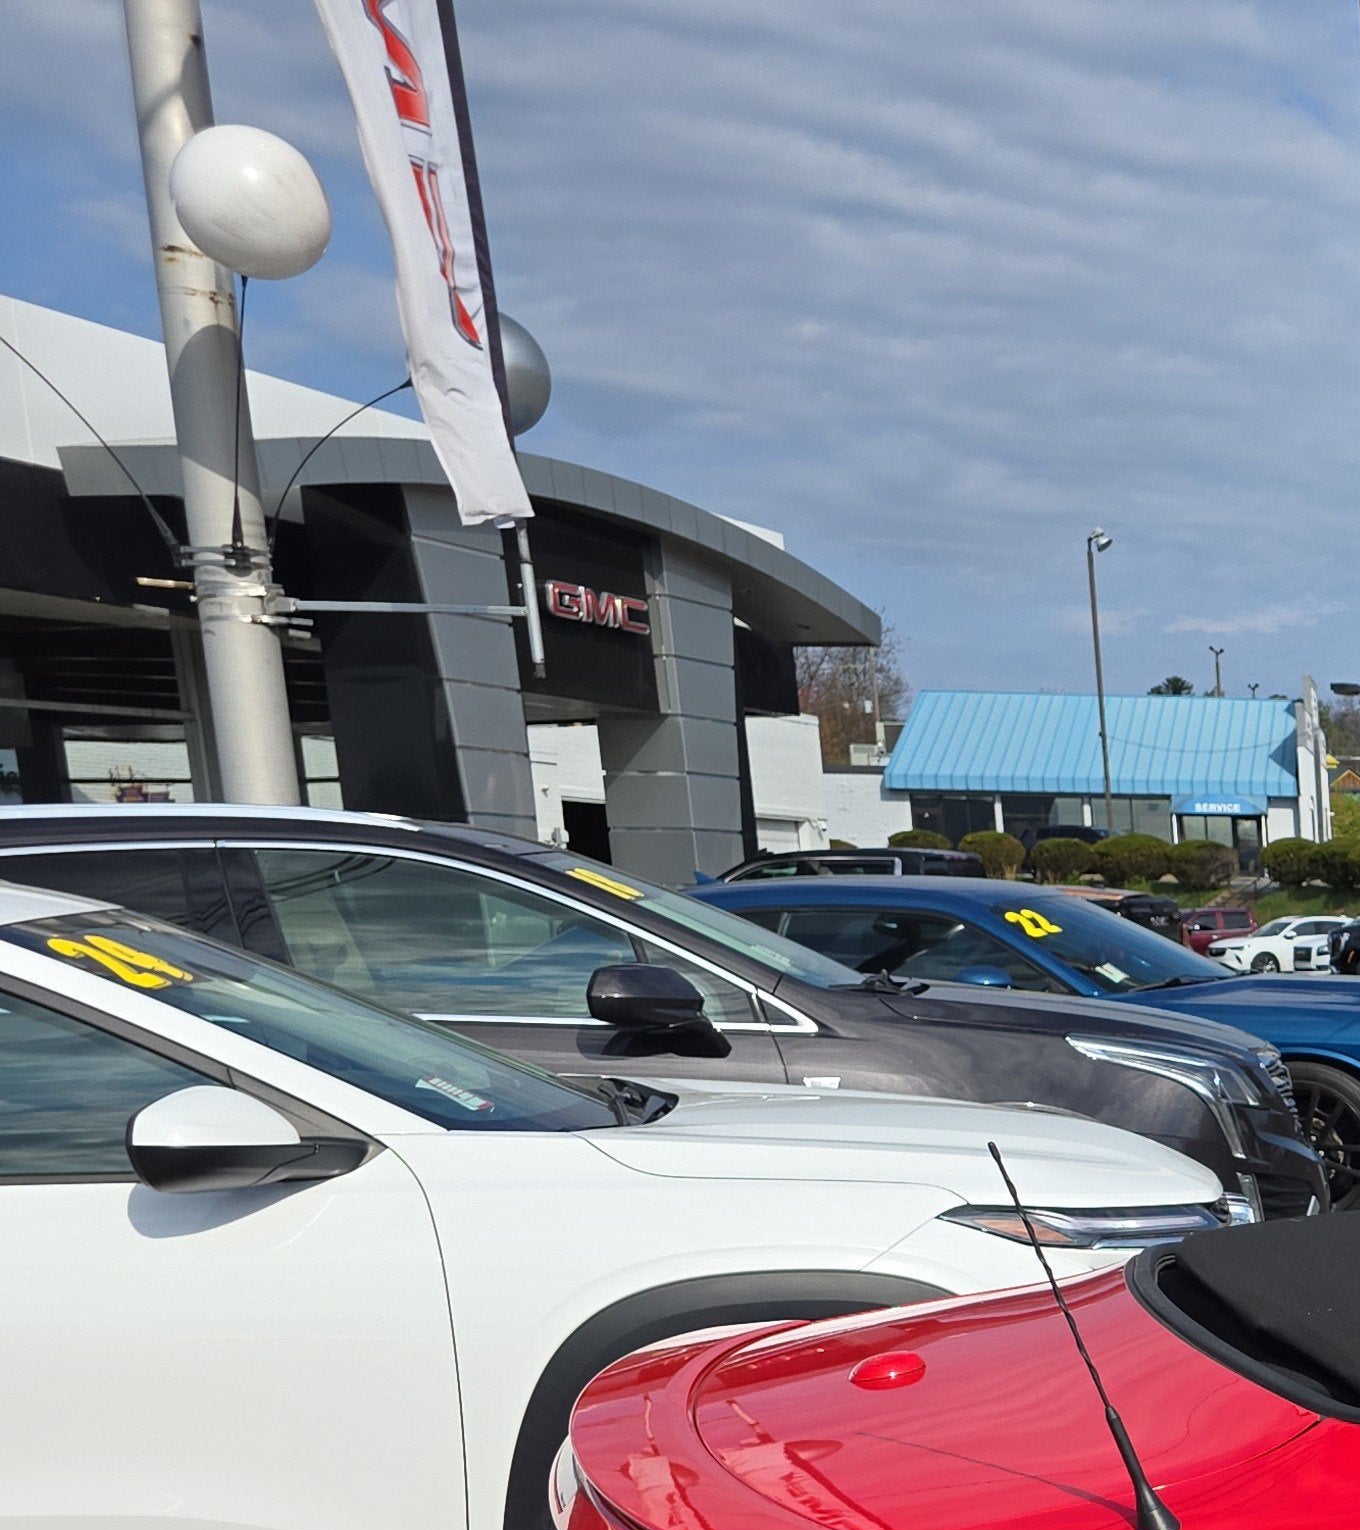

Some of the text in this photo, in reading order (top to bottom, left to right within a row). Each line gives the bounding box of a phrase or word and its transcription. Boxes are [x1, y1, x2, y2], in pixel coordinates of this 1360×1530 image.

[544, 580, 651, 635] GMC
[1194, 802, 1241, 814] SERVICE
[1004, 909, 1063, 938] 22
[46, 934, 194, 989] 24
